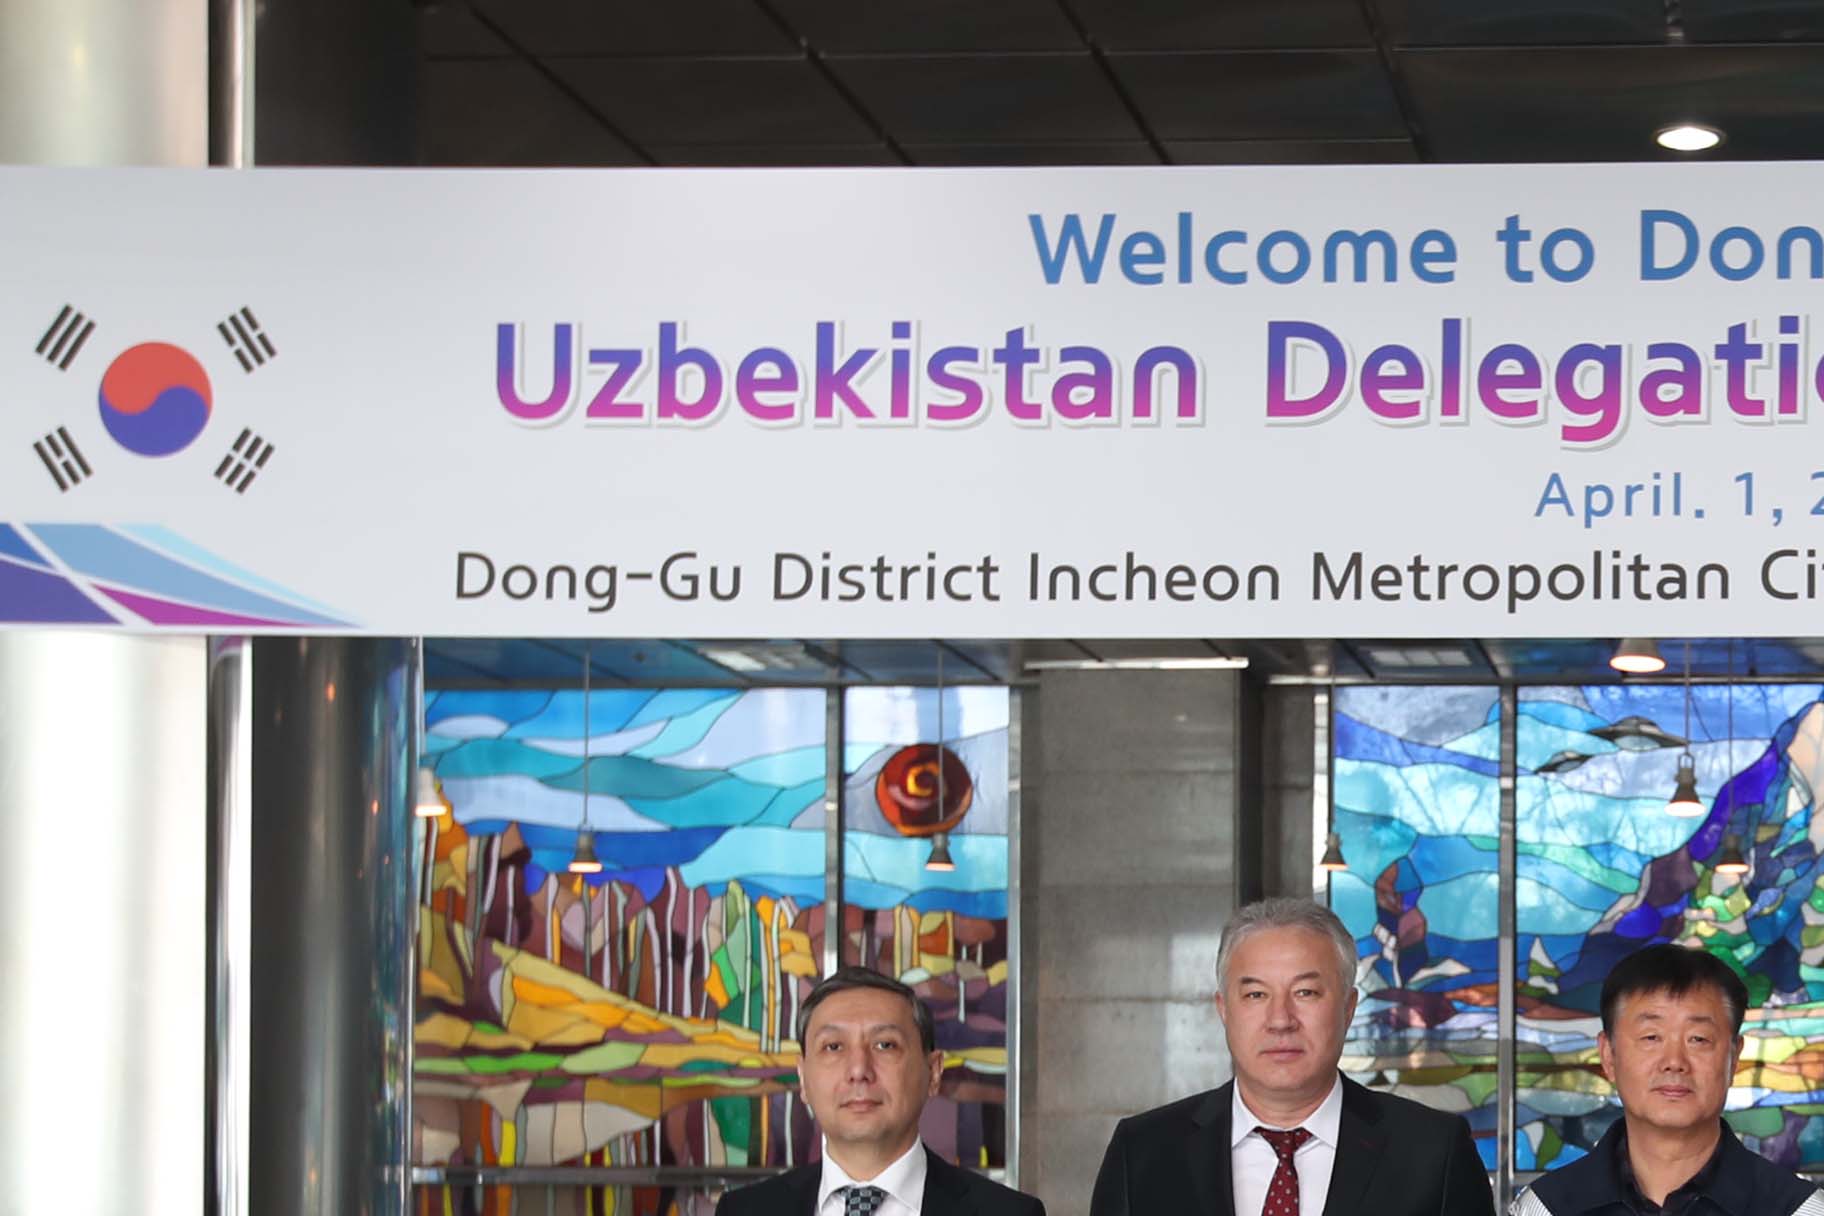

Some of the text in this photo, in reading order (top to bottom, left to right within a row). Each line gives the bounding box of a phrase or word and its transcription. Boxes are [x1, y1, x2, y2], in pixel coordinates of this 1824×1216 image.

[1028, 210, 1459, 286] Welcome
[1496, 214, 1597, 284] to
[496, 320, 1199, 424] Uzbekistan
[1534, 472, 1708, 528] April.
[1733, 471, 1785, 525] 1,
[455, 551, 743, 614] Dong-Gu
[772, 551, 1001, 603] District
[1028, 551, 1281, 603] Incheon
[1311, 548, 1731, 615] Metropolitan
